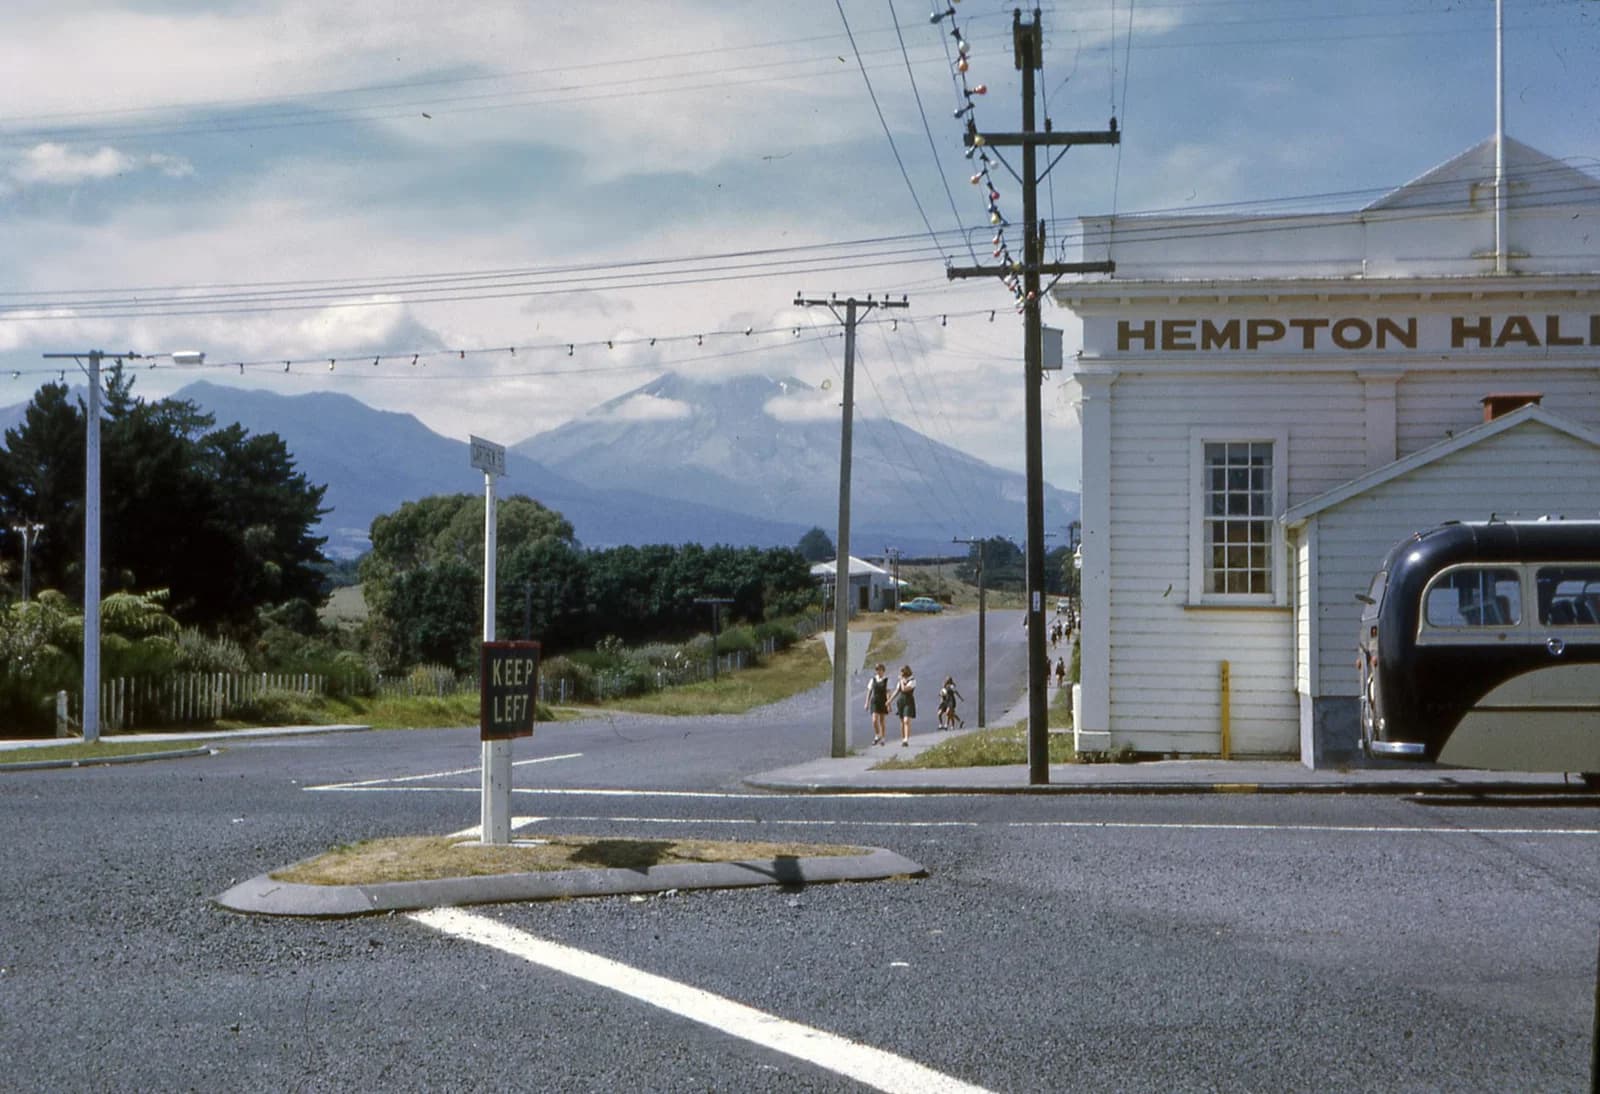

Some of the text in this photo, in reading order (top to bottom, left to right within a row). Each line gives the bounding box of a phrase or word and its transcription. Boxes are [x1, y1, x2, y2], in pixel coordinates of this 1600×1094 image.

[1117, 317, 1417, 351] HEMPTON
[493, 658, 533, 686] KEEP
[494, 694, 528, 724] LEFT
